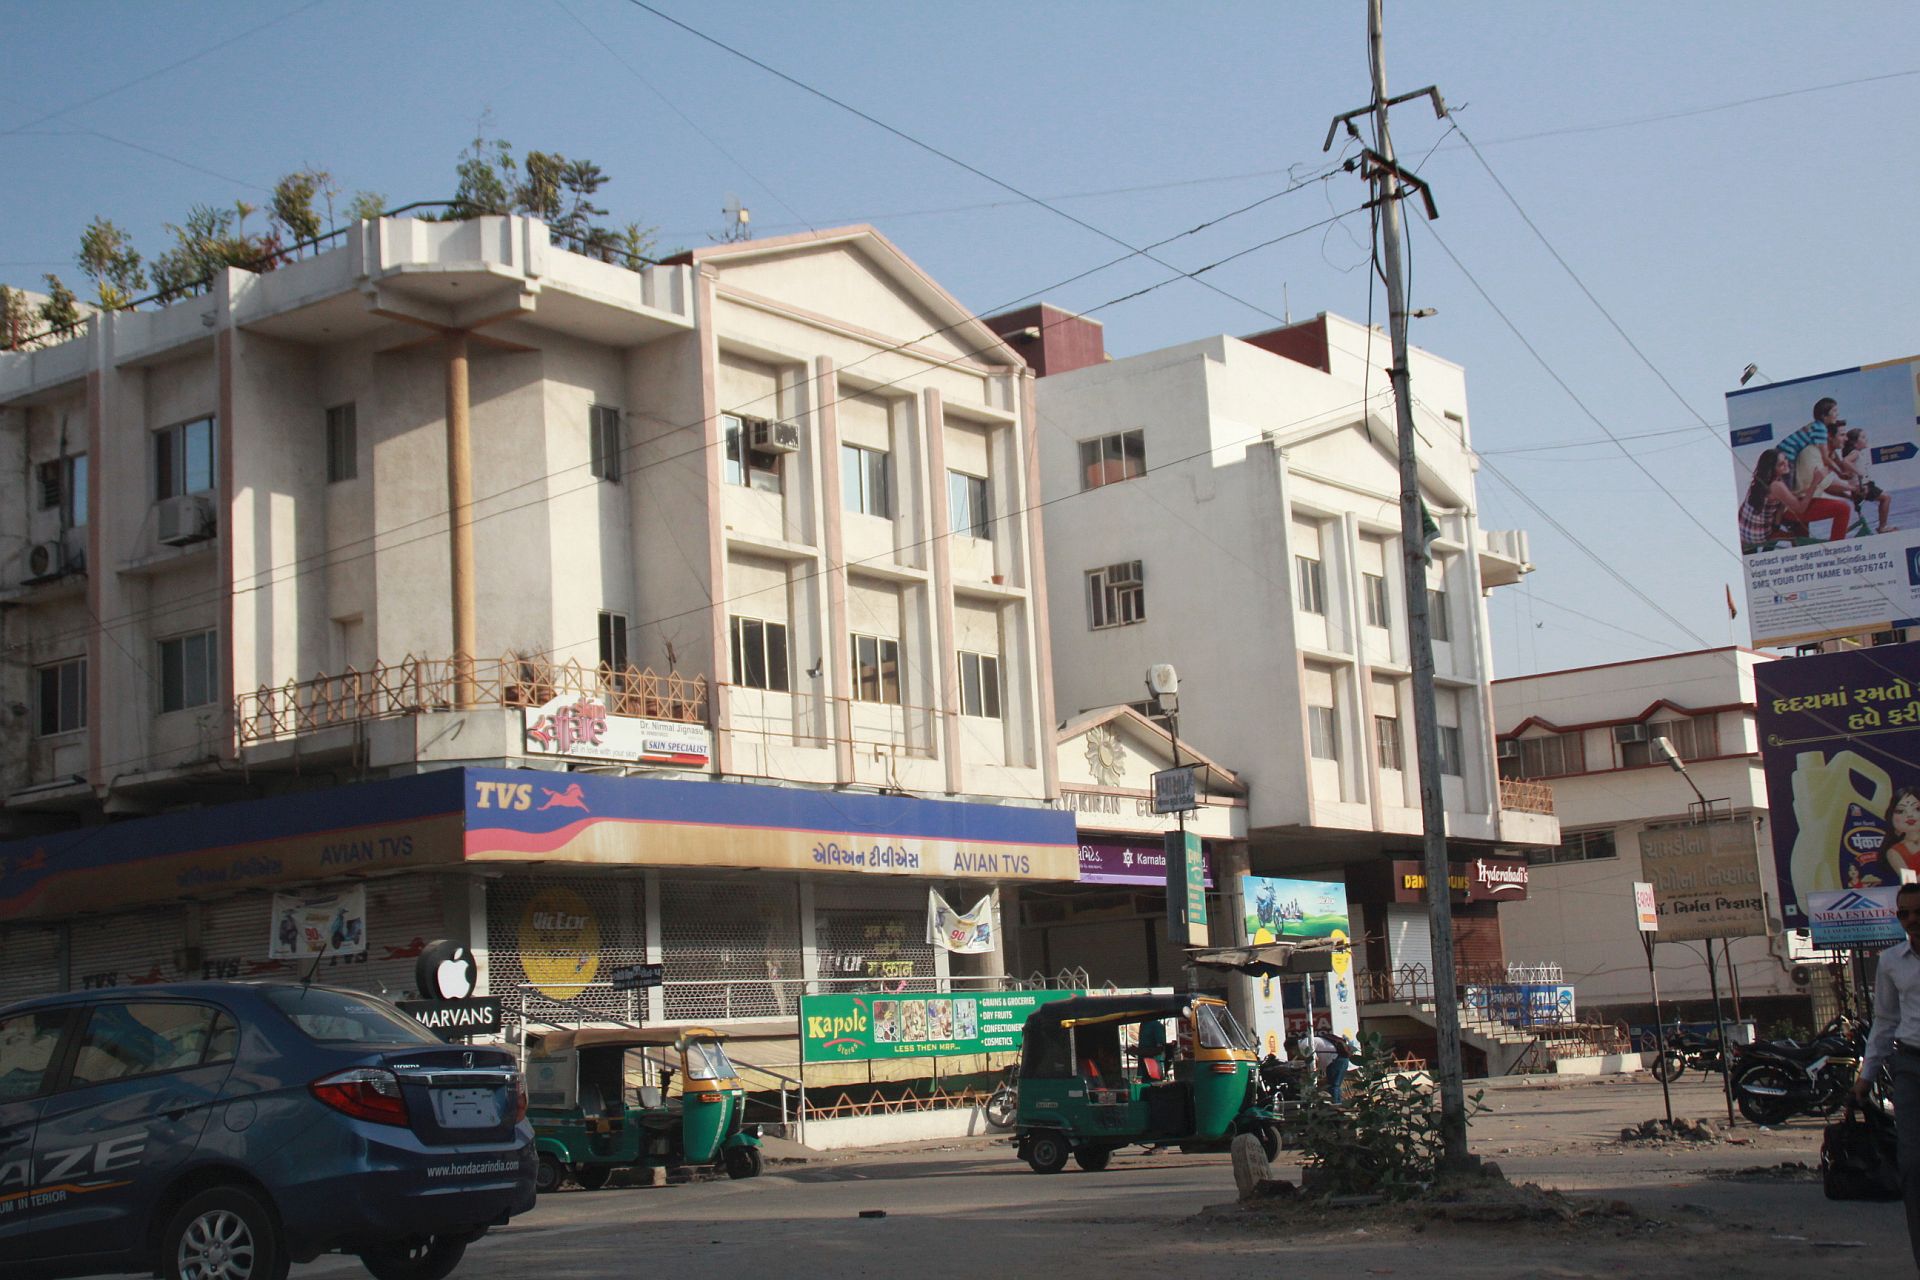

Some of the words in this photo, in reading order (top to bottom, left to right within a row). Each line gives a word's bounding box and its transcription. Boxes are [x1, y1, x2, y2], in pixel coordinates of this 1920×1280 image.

[1750, 555, 1779, 568] Contact
[1781, 552, 1797, 566] your
[1854, 543, 1863, 551] or
[1770, 568, 1782, 576] our
[1784, 562, 1814, 575] website
[1878, 551, 1887, 560] or
[1752, 580, 1770, 590] SMS
[1772, 576, 1796, 587] YOUR
[1797, 573, 1815, 583] CITY
[1817, 568, 1841, 580] NAME
[639, 720, 650, 730] Dr.
[652, 721, 675, 733] Nirmal
[1848, 706, 1882, 731] હવે
[648, 740, 666, 751] SKIN
[668, 742, 708, 754] SPECIALIST
[475, 781, 534, 812] TVS
[320, 841, 374, 867] AVIAN
[379, 835, 413, 857] TVS
[1137, 853, 1166, 866] Karnata
[954, 852, 998, 873] AVIAN
[1002, 854, 1030, 874] TVS
[1477, 858, 1529, 889] Hyderabadi's
[1814, 911, 1842, 921] NIRA
[1846, 908, 1895, 919] ESTATES
[950, 929, 965, 942] 90
[202, 958, 241, 980] TVS
[982, 997, 1001, 1007] GRAINS
[1007, 997, 1035, 1006] GROCERIES
[416, 1007, 493, 1029] MARVANS
[808, 1008, 867, 1039] Kapole
[983, 1012, 993, 1020] DRY
[994, 1011, 1013, 1019] FRUITS
[894, 1045, 915, 1053] LESS
[985, 1037, 1013, 1046] COSMETICS
[427, 1160, 519, 1177] www.hondacarindia.com
